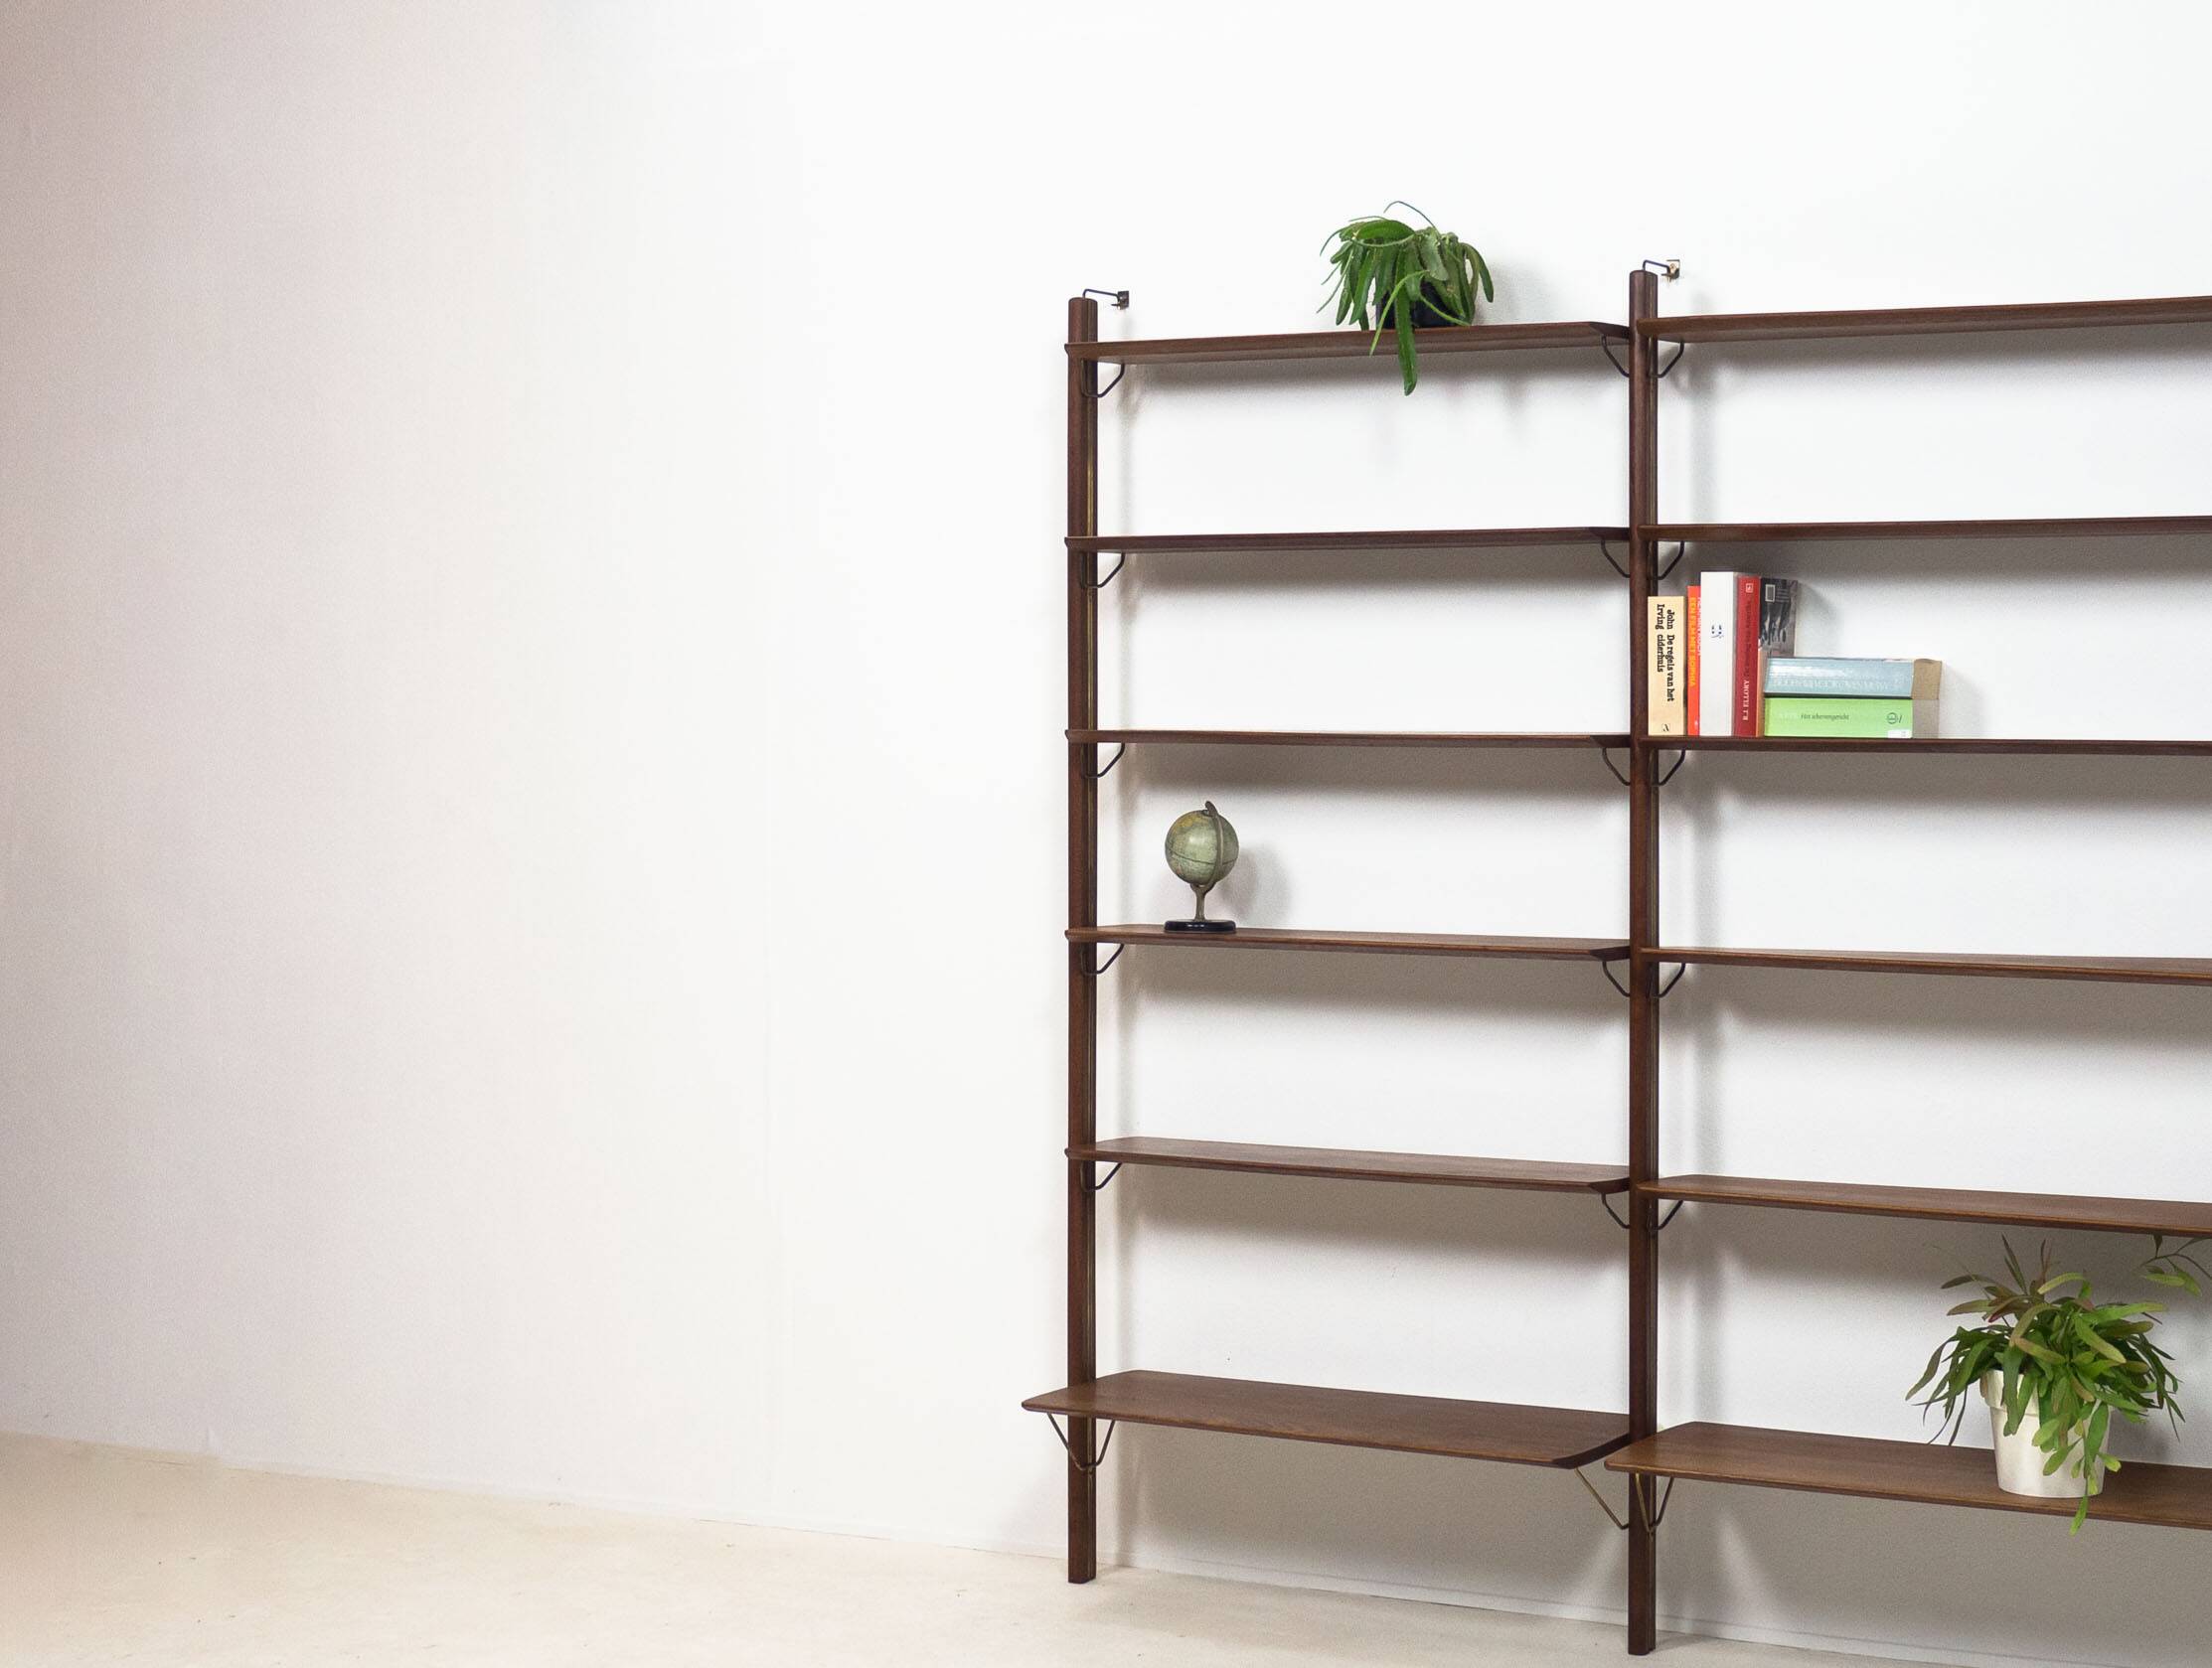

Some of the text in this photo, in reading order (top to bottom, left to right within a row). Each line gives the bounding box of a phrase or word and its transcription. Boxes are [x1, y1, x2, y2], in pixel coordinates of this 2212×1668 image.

[1656, 604, 1664, 630] Irving
[1666, 635, 1674, 646] De
[1664, 646, 1674, 671] regels
